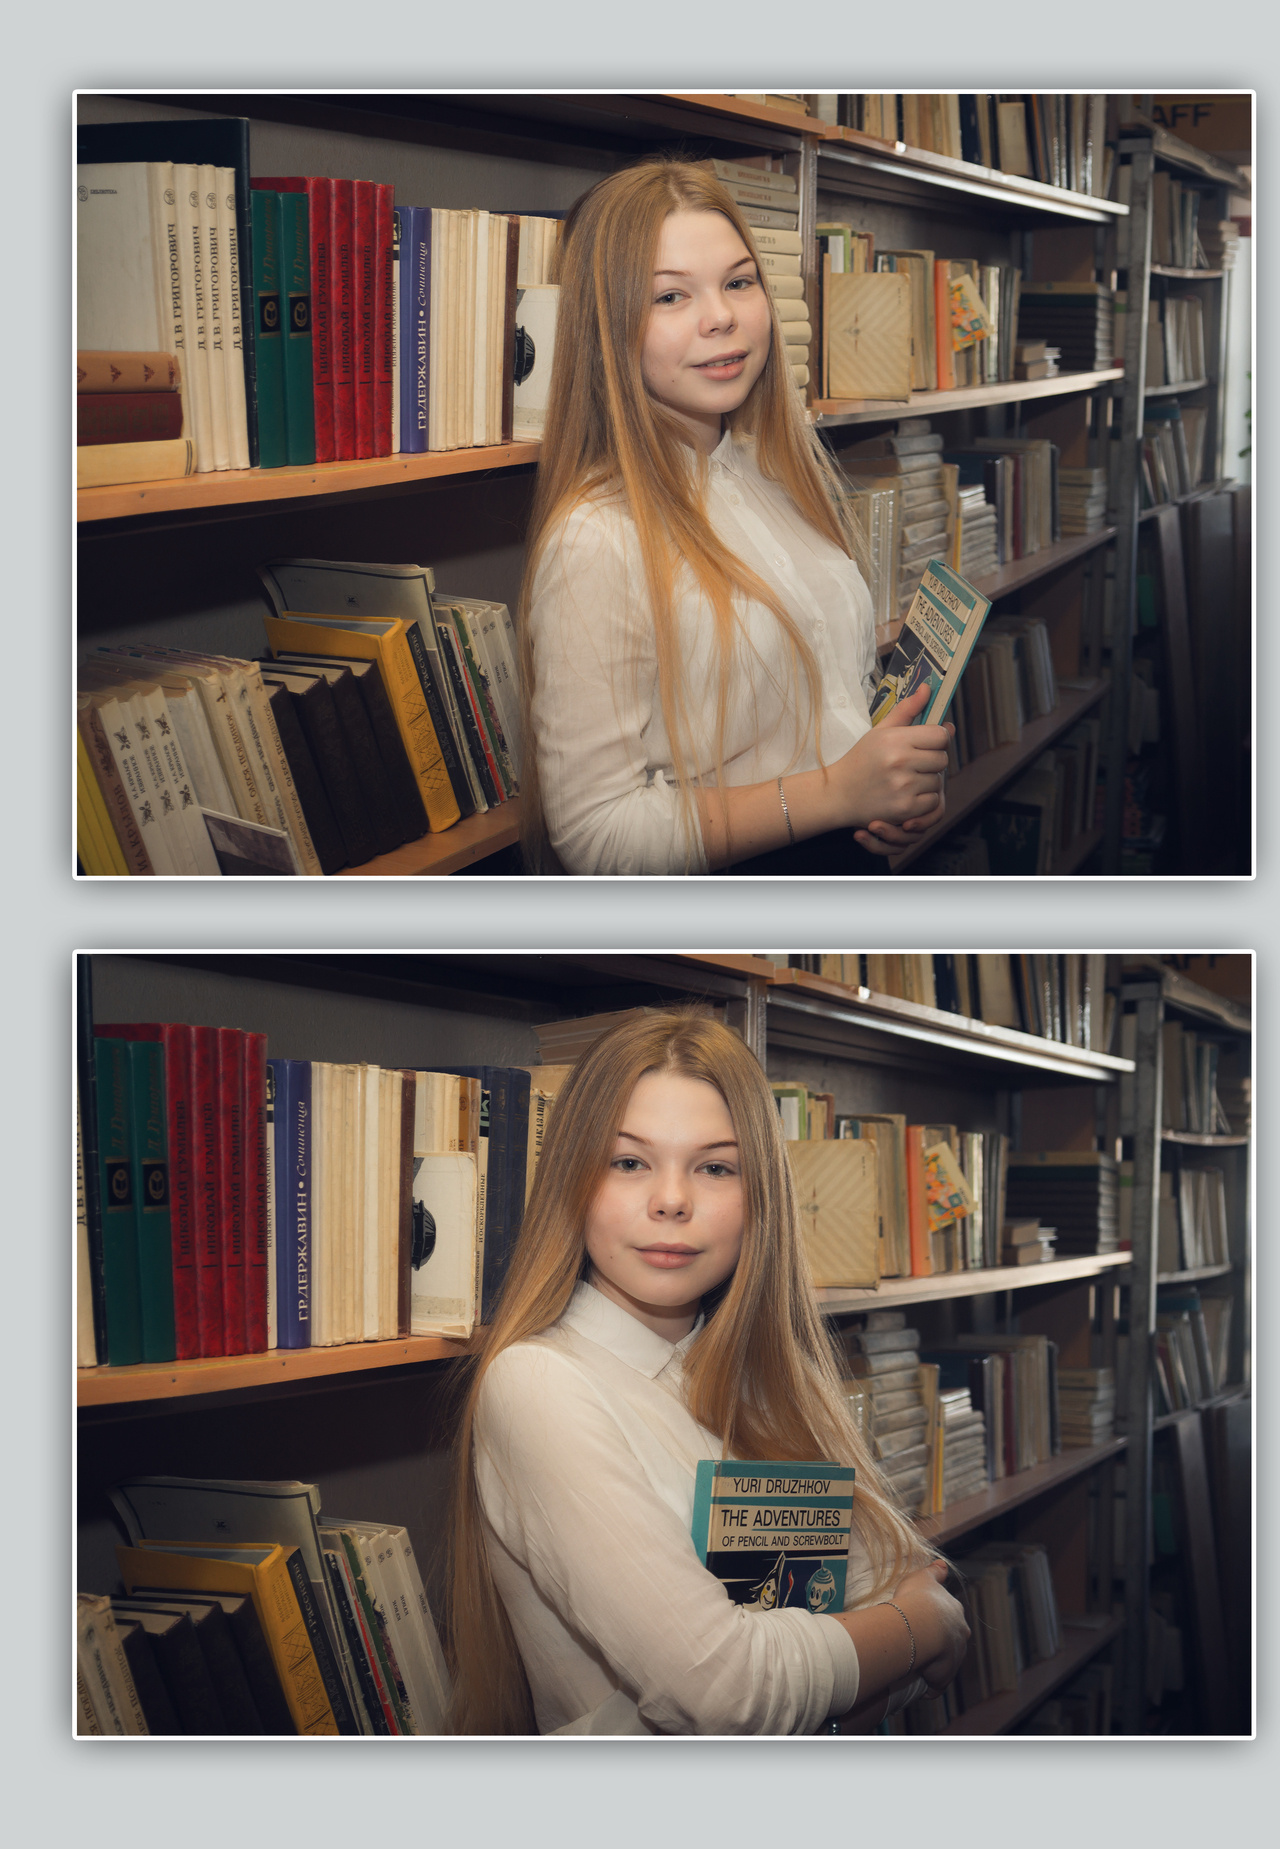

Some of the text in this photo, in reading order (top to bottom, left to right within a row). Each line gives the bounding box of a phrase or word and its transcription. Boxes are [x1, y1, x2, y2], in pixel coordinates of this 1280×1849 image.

[168, 223, 182, 319] ГРИГОРОВИЧ
[192, 225, 205, 319] ГРИГОРОВИЧ
[209, 227, 220, 321] ГРИГОРОВИЧ
[229, 227, 240, 320] ГРИГОРОВИЧ
[317, 242, 329, 374] НИКОЛАЙ ГУМИЛЕВ
[340, 243, 351, 374] НИКОЛАЙ ГУМИЛЕВ
[363, 245, 372, 374] НИКОЛАЙ ГУМИЛЕВ
[417, 241, 428, 307] Сочинения
[408, 632, 432, 689] Рассказы
[916, 595, 955, 645] THE ADVENTURES
[128, 753, 146, 794] ИЗБРАННОЕ
[147, 743, 166, 783] ИЗБРАННОЕ
[168, 739, 186, 779] ИЗБРАННОЕ
[224, 711, 258, 798] ОЛЕСЯ ПОЕДИНОК
[176, 1100, 190, 1255] НИКОЛАЙ ГУМИЛЕВ
[204, 1102, 216, 1255] НИКОЛАЙ ГУМИЛЕВ
[231, 1104, 242, 1254] НИКОЛАЙ ГУМИЛЕВ
[296, 1101, 308, 1177] Сочинения
[721, 1509, 841, 1527] THE ADVENTURES
[733, 1478, 831, 1494] YURI DRUZHKOV
[722, 1534, 844, 1547] OF PENCIL AND SCREWBOLT
[290, 1561, 318, 1628] Рассказы
